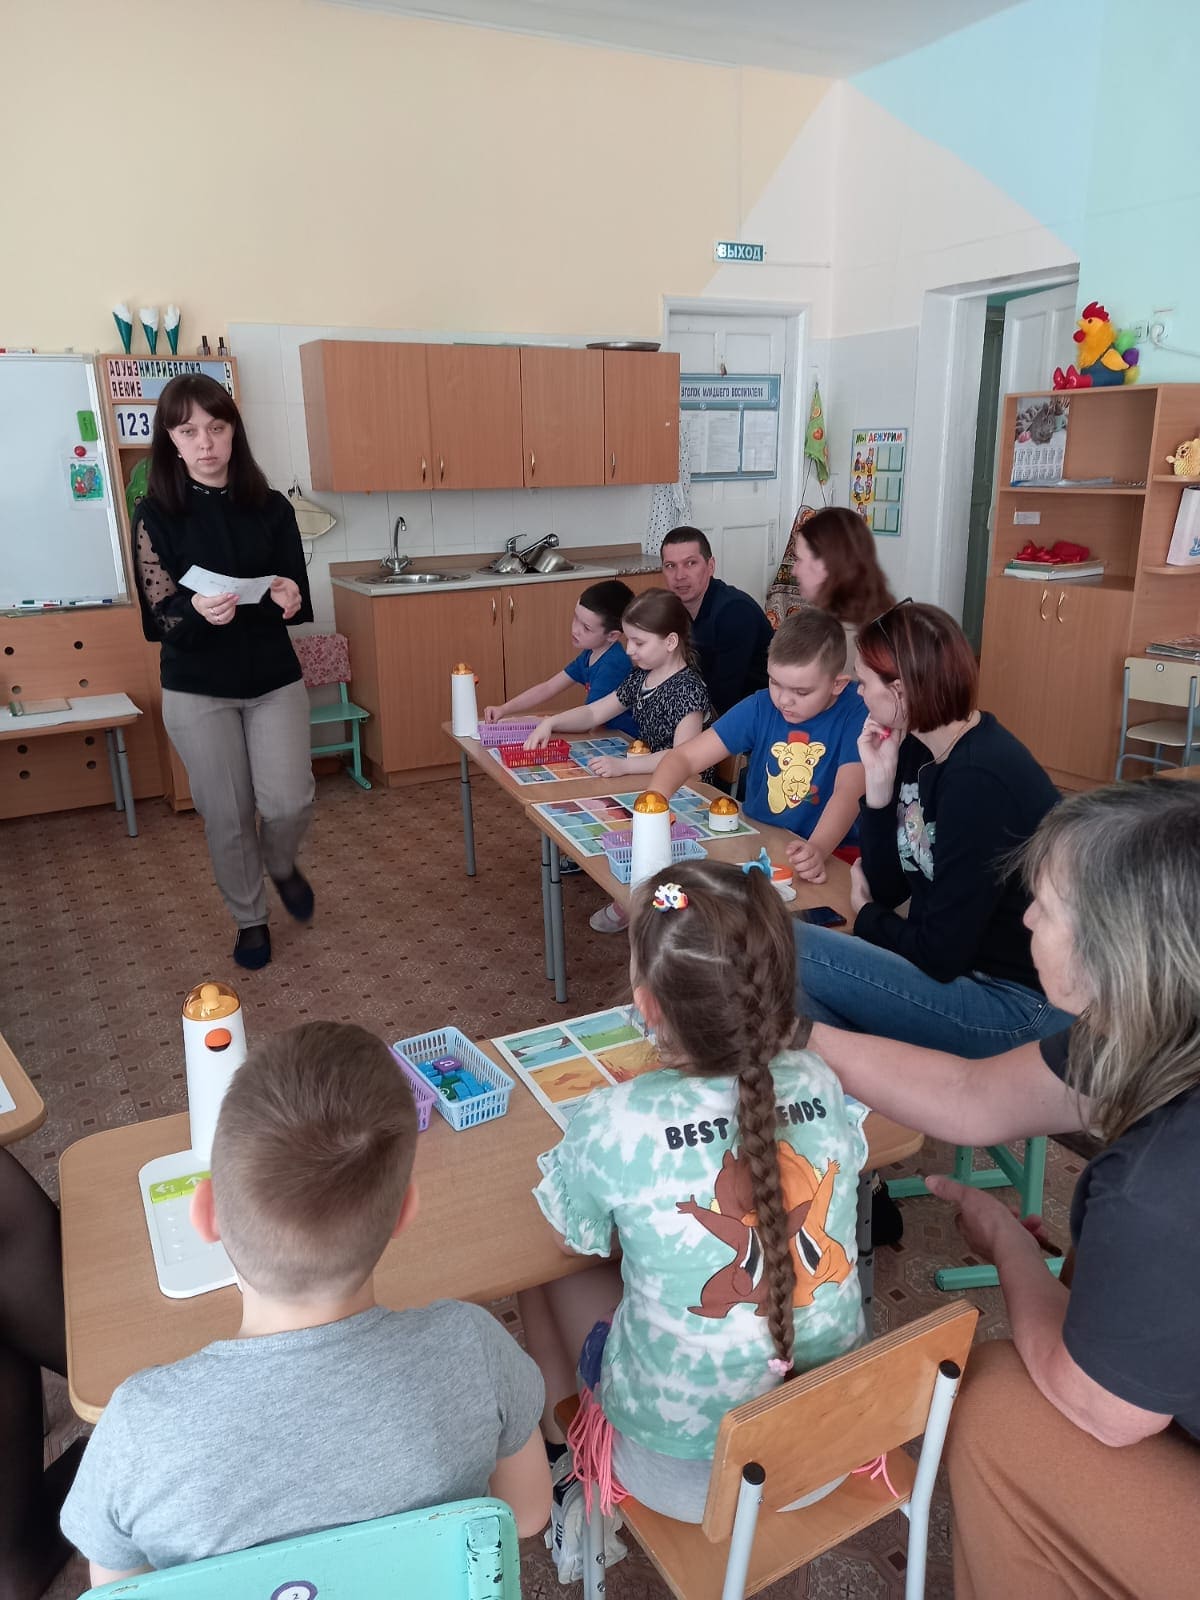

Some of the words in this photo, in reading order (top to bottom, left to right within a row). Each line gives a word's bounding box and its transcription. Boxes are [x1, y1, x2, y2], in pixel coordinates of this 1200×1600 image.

[718, 244, 761, 260] ВЫХОД
[703, 387, 729, 397] МЛАДШЕГО
[117, 412, 150, 437] 123
[856, 433, 866, 444] МЫ
[868, 432, 903, 443] ДЕЖУРИМ
[665, 1118, 729, 1150] BEST
[776, 1097, 827, 1127] ENDS
